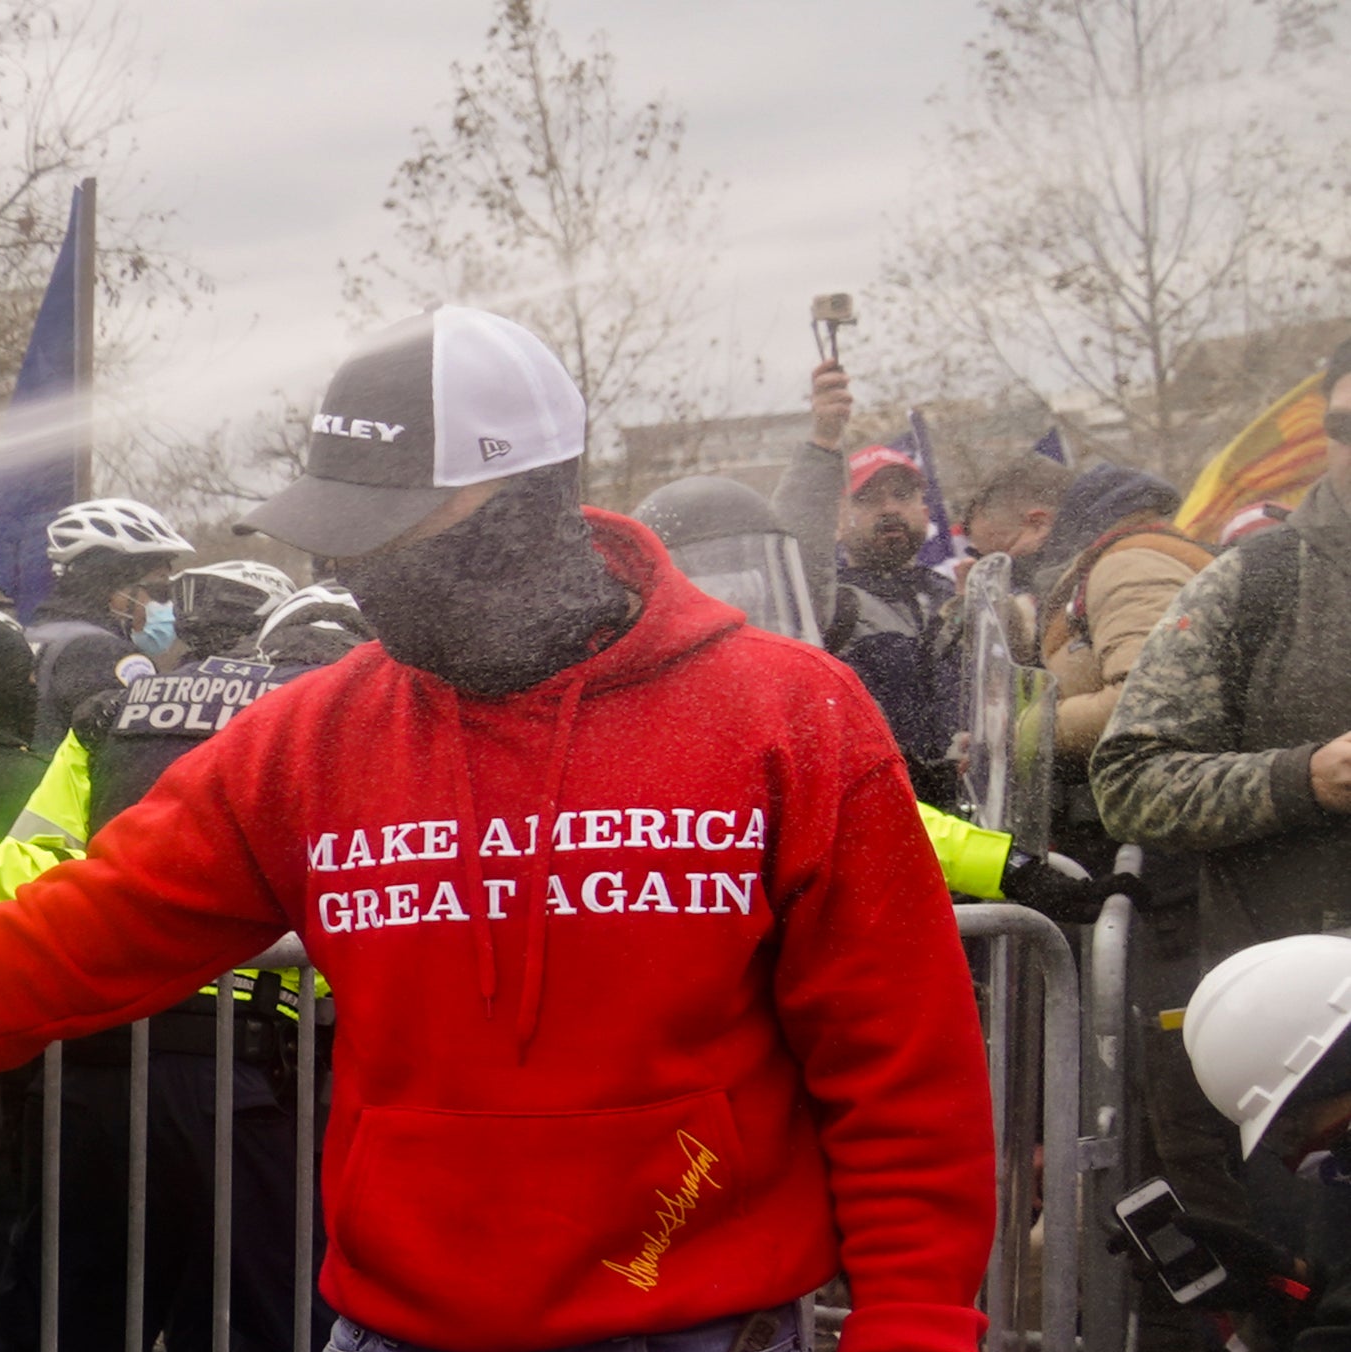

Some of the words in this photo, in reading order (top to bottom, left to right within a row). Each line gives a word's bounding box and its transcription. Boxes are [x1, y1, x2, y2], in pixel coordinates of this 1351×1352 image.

[311, 413, 405, 443] KLEY
[128, 676, 283, 707] METROPOLIT
[117, 702, 235, 731] POLI
[307, 819, 459, 872] MAKE
[478, 807, 765, 858] AMERICA
[318, 879, 516, 934] GREAT
[546, 870, 758, 916] AGAIN
